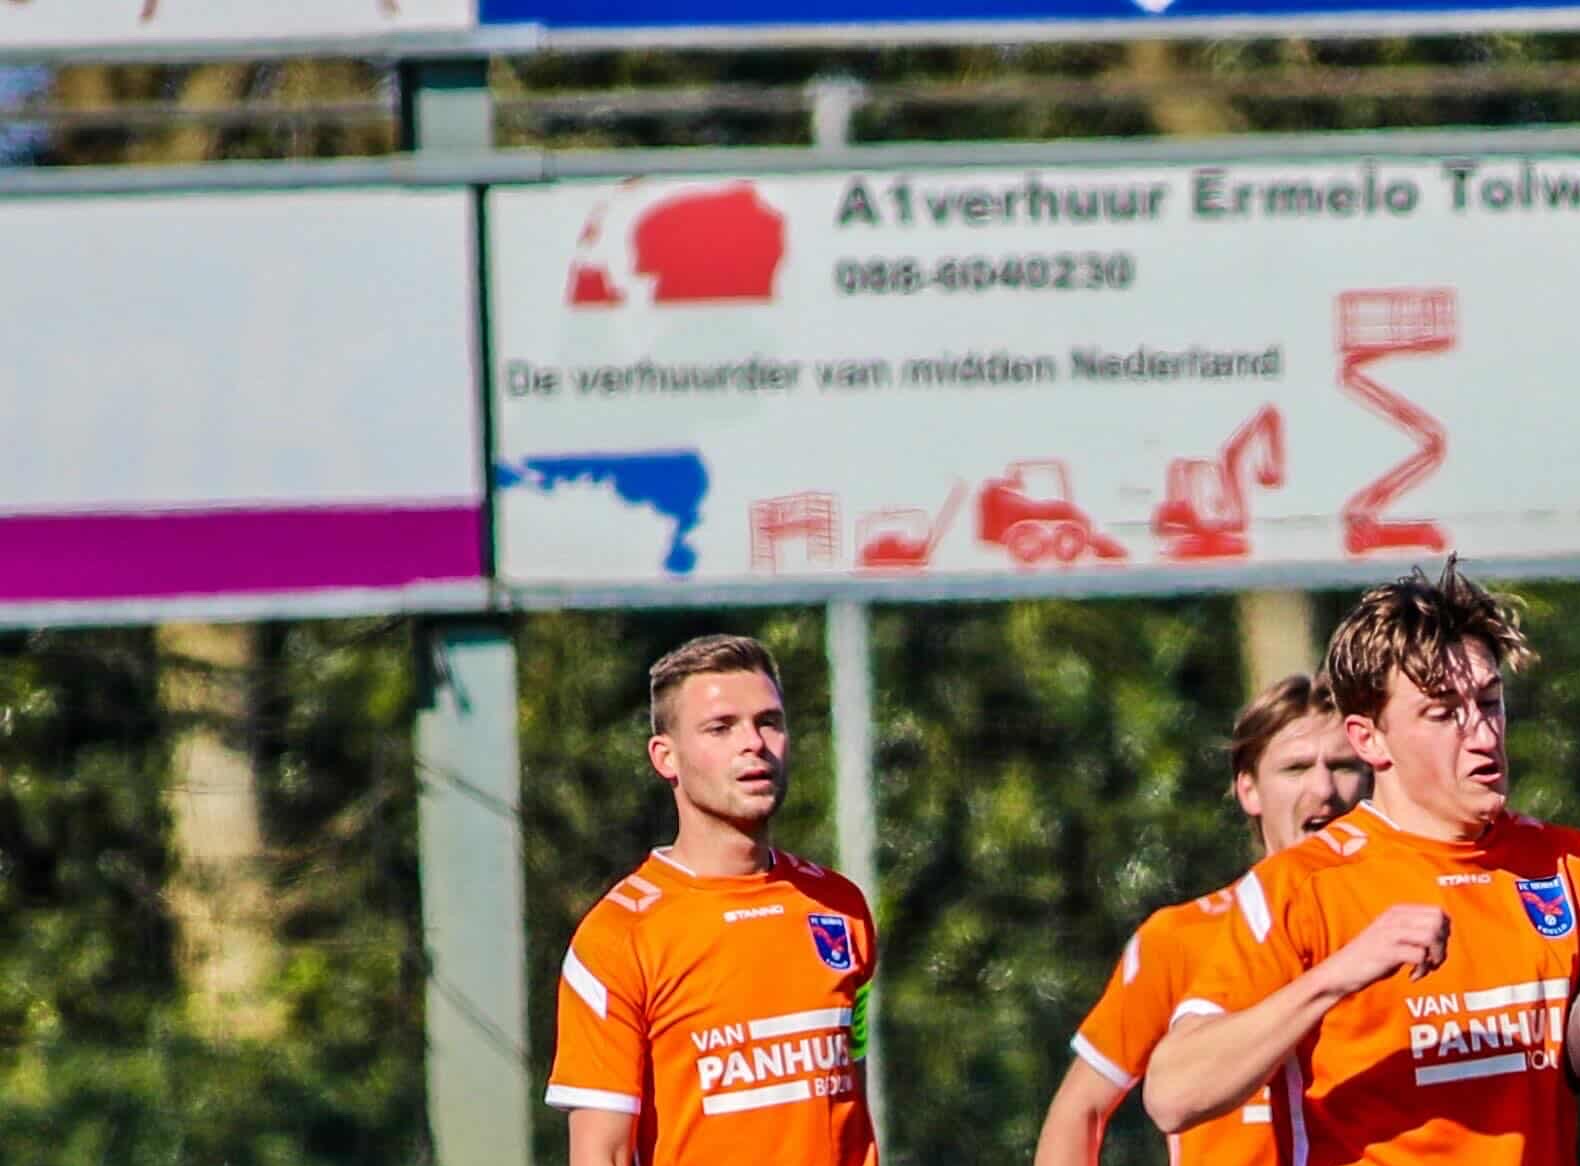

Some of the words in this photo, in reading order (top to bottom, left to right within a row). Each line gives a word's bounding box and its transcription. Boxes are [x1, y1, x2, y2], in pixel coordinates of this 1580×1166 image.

[836, 174, 1166, 226] A1verhuur
[1192, 166, 1418, 213] Ermelo
[506, 358, 557, 396] De
[815, 354, 886, 388] van
[1405, 993, 1459, 1018] VAN
[691, 1023, 744, 1052] VAN
